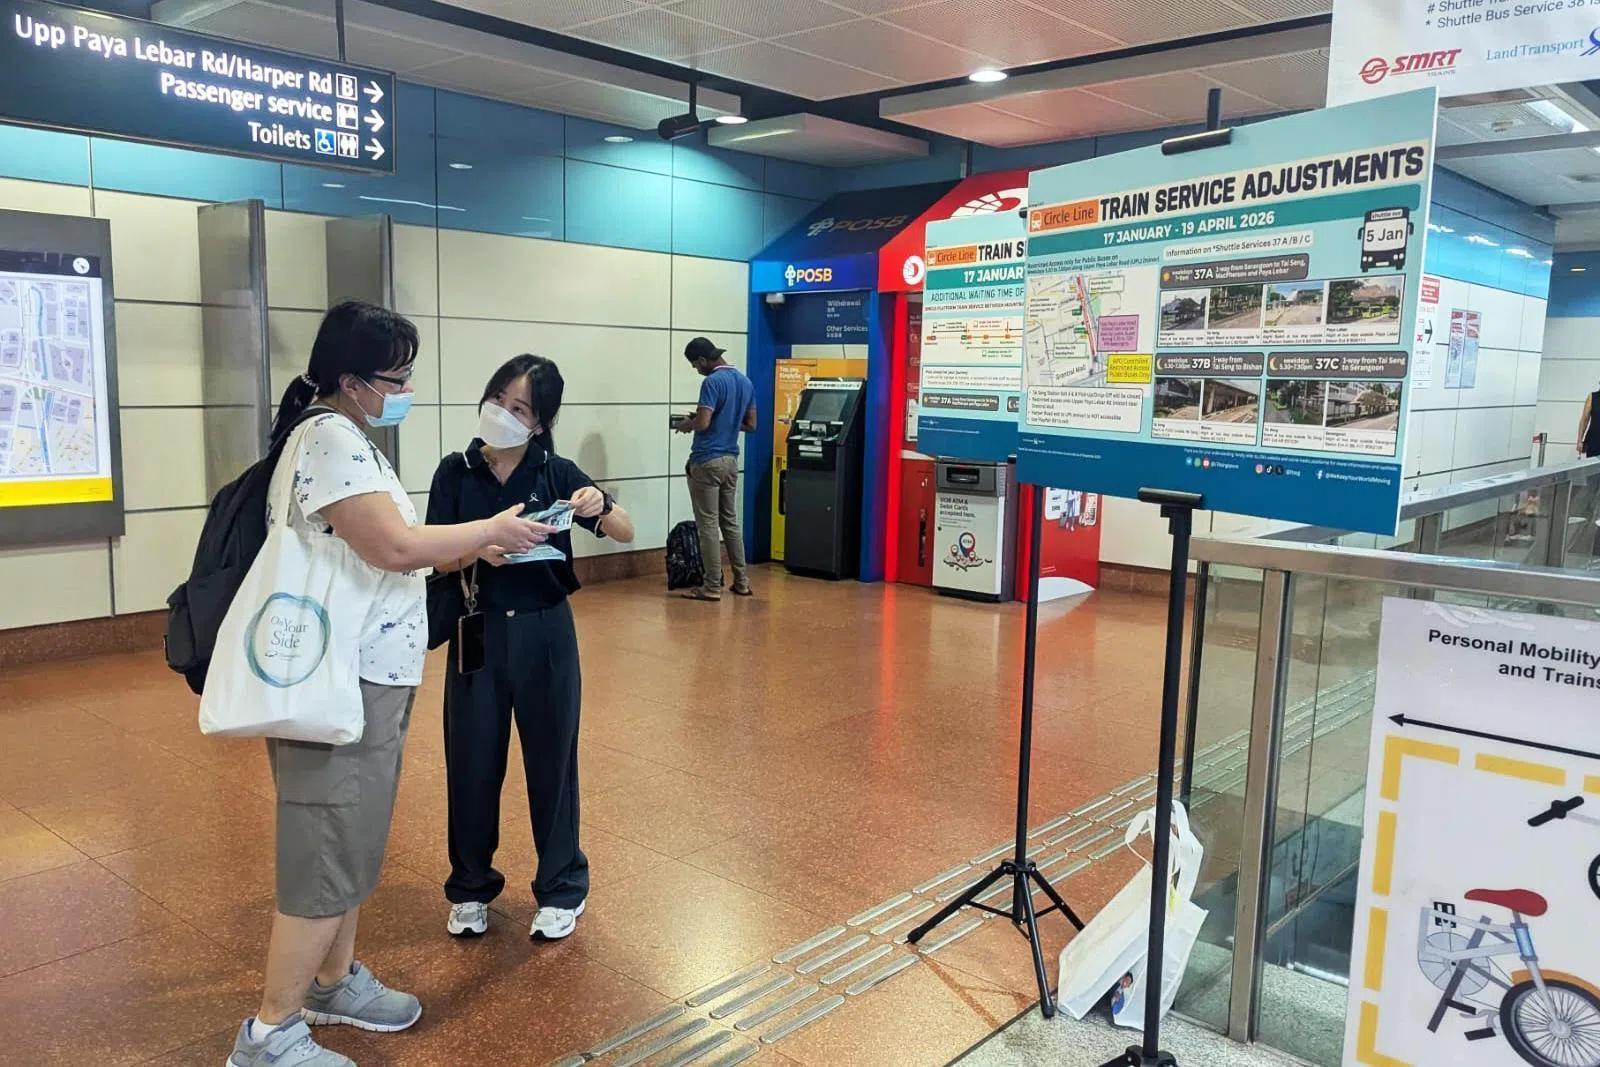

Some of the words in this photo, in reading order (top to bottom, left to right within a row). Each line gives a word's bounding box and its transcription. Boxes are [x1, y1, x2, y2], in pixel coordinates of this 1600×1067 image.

[1437, 13, 1482, 28] Shuttle
[1485, 10, 1510, 21] Bus
[1513, 2, 1564, 17] Service
[1438, 0, 1483, 13] Shuttle
[15, 14, 65, 48] Upp
[74, 25, 127, 61] Paya
[135, 37, 196, 69] Lebar
[201, 50, 303, 90] Rd/Harper
[309, 71, 332, 95] Rd
[341, 77, 354, 96] B
[1486, 46, 1518, 61] Land
[1520, 38, 1585, 58] Transport
[1391, 48, 1463, 73] SMRT
[160, 73, 264, 113] Passenger
[267, 94, 333, 122] service
[248, 121, 311, 150] Toilets
[1043, 209, 1070, 225] Circle
[1073, 206, 1094, 221] Line
[1100, 192, 1149, 221] TRAIN
[1155, 176, 1235, 213] SERVICE
[1241, 146, 1424, 202] ADJUSTMENTS
[829, 215, 908, 233] POSB
[1103, 231, 1116, 245] 17
[1117, 224, 1172, 242] JANUARY
[1181, 221, 1195, 235] 19
[1197, 214, 1237, 234] APRIL
[1240, 210, 1275, 230] 2026
[1366, 229, 1375, 242] 5
[1377, 228, 1404, 242] Jan
[937, 252, 956, 263] Circle
[957, 250, 974, 261] Line
[978, 242, 1012, 260] TRAIN
[1166, 247, 1202, 257] Information
[1241, 239, 1271, 250] Services
[796, 268, 833, 283] POSB
[964, 271, 976, 283] 17
[976, 267, 1024, 283] JANUAR
[1194, 268, 1214, 280] 37A
[931, 291, 967, 302] ADDITIONAL
[969, 289, 996, 299] WAITING
[997, 288, 1013, 297] TIME
[1192, 358, 1211, 369] 37B
[1315, 358, 1339, 370] 37C
[1349, 364, 1385, 373] Serangoon
[284, 618, 308, 633] Your
[271, 630, 301, 649] Side
[1428, 629, 1513, 654] Personal
[1520, 642, 1600, 670] Mobility
[1498, 663, 1535, 679] and
